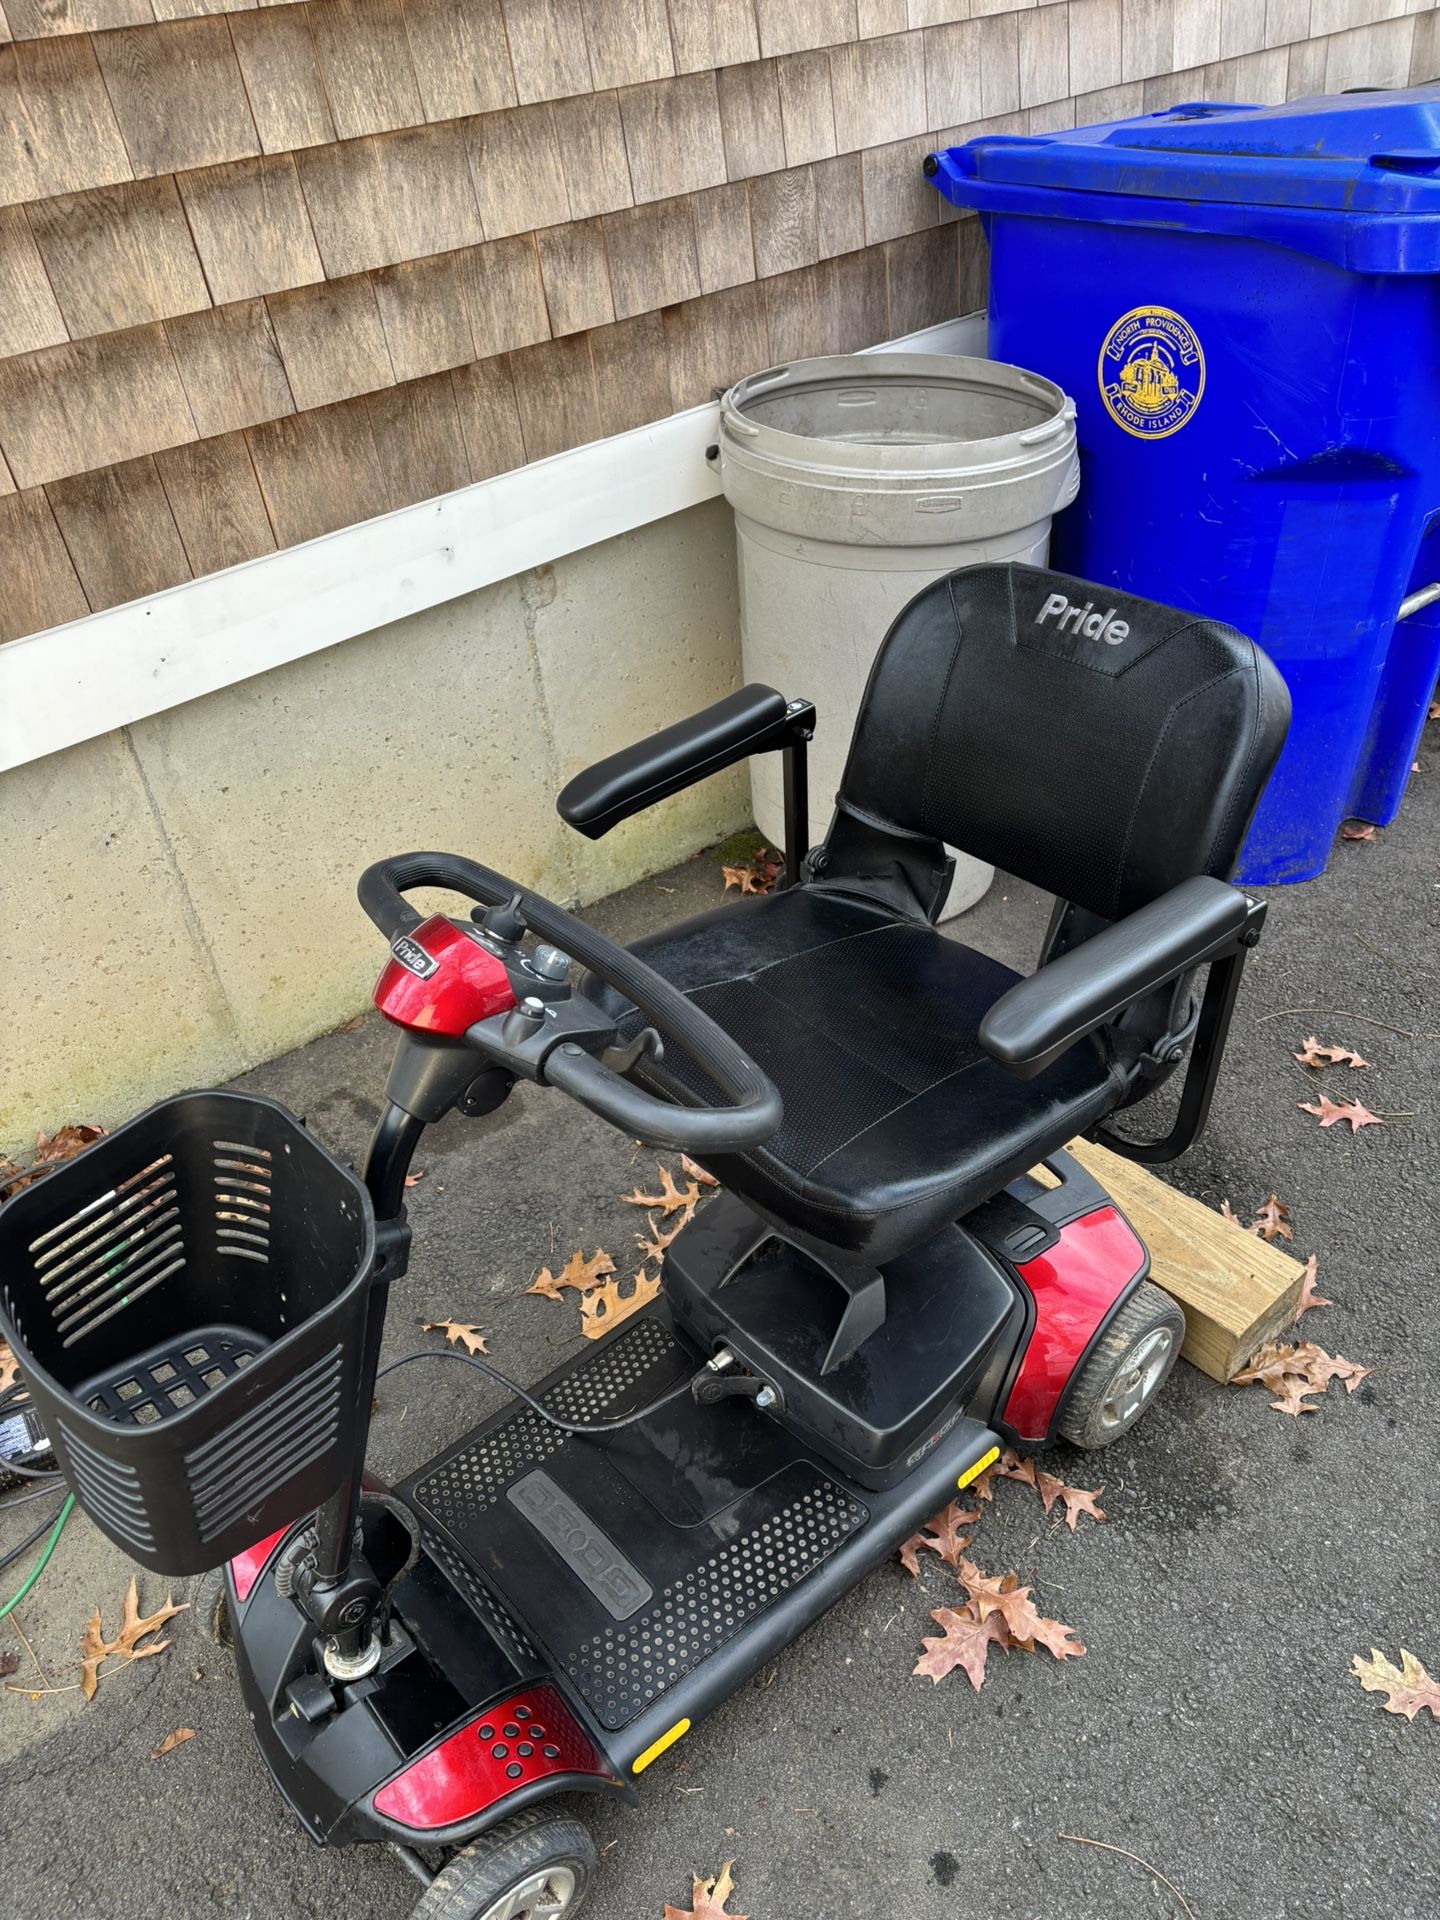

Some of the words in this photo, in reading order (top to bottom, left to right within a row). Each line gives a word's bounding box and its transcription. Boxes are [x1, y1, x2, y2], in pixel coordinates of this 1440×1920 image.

[1116, 321, 1140, 344] NORTH
[1145, 318, 1191, 349] PROVIDENCE
[1116, 402, 1145, 427] RHODE
[1148, 407, 1182, 429] ISLAND
[1034, 593, 1130, 646] Pride
[395, 941, 425, 970] Pride
